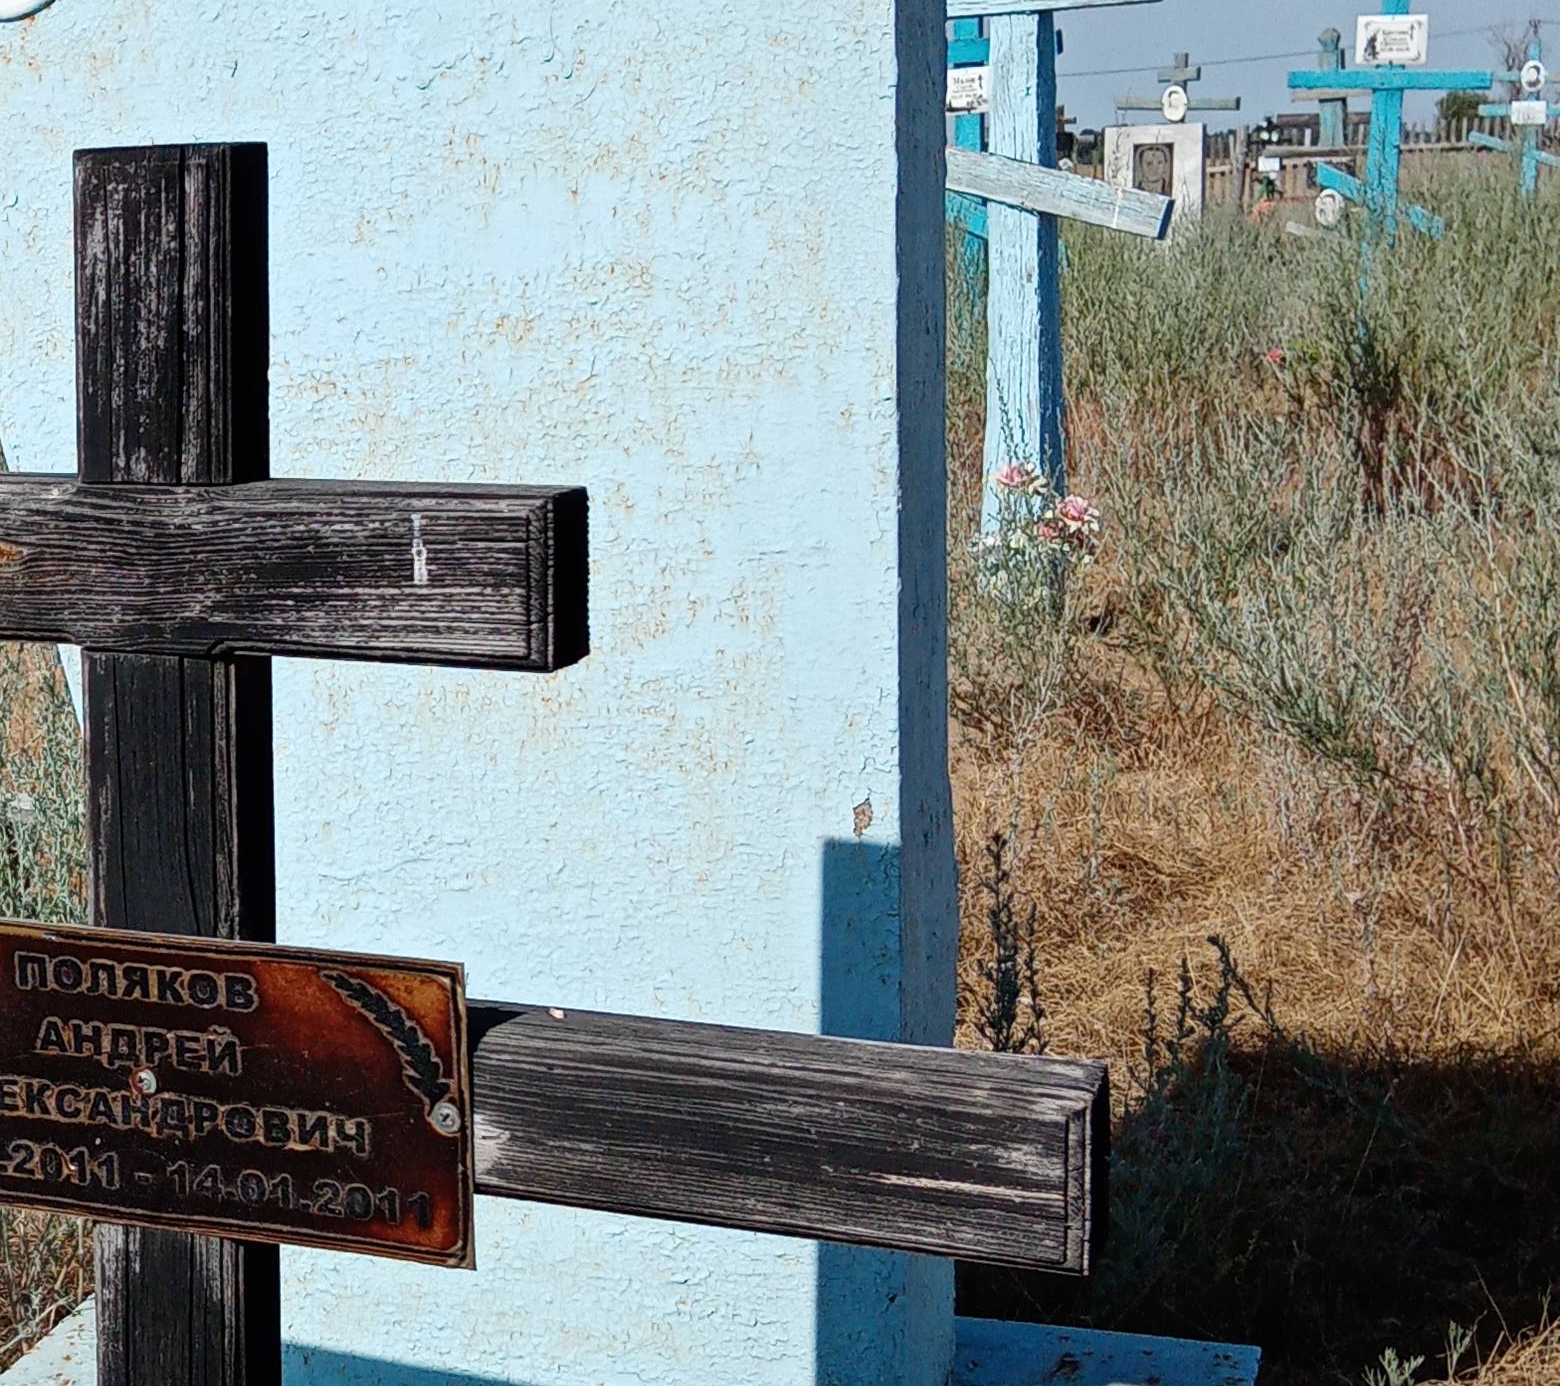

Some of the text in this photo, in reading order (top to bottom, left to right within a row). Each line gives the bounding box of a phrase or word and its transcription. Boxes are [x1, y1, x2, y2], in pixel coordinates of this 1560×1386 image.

[14, 950, 260, 1013] ПОЛЯКОВ
[33, 1016, 244, 1076] АНДРЕЙ
[167, 1161, 435, 1231] 14.01.2011
